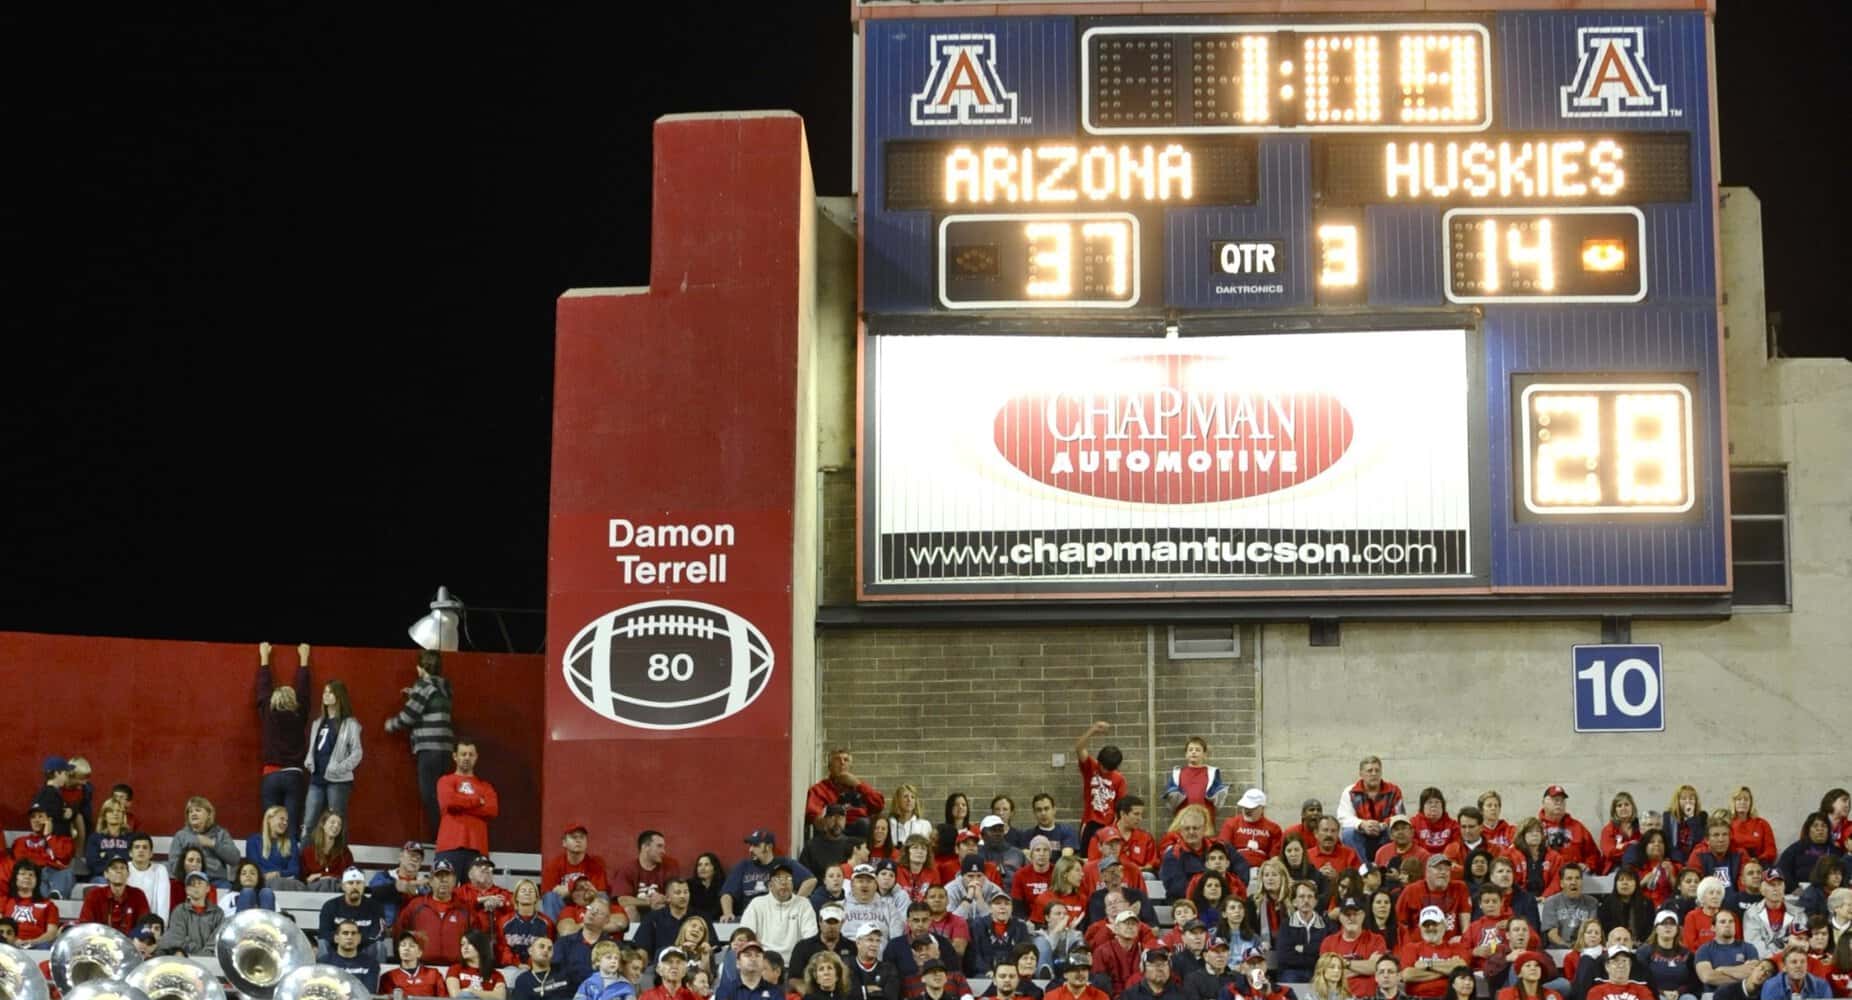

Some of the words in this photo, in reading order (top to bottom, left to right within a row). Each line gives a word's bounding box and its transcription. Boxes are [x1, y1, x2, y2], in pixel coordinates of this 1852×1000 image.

[910, 33, 1018, 126] A
[1240, 33, 1480, 123] 1:09
[1560, 26, 1668, 118] A
[944, 143, 1193, 204] ARIZONA
[1385, 139, 1626, 198] HUSKIES
[1025, 221, 1130, 297] 37
[1220, 243, 1276, 275] QTR
[1318, 223, 1358, 288] 3
[1480, 217, 1557, 293] 14
[1215, 285, 1284, 295] DAKTRONICS
[1046, 389, 1297, 441] CHAPMAN
[1051, 448, 1298, 475] AUTOMOTIVE
[1534, 393, 1684, 507] 28
[608, 518, 735, 548] Damon
[909, 537, 1437, 569] www.chapmantucson.com
[616, 553, 727, 585] Terrell
[647, 652, 695, 682] 80
[1577, 658, 1659, 717] 10
